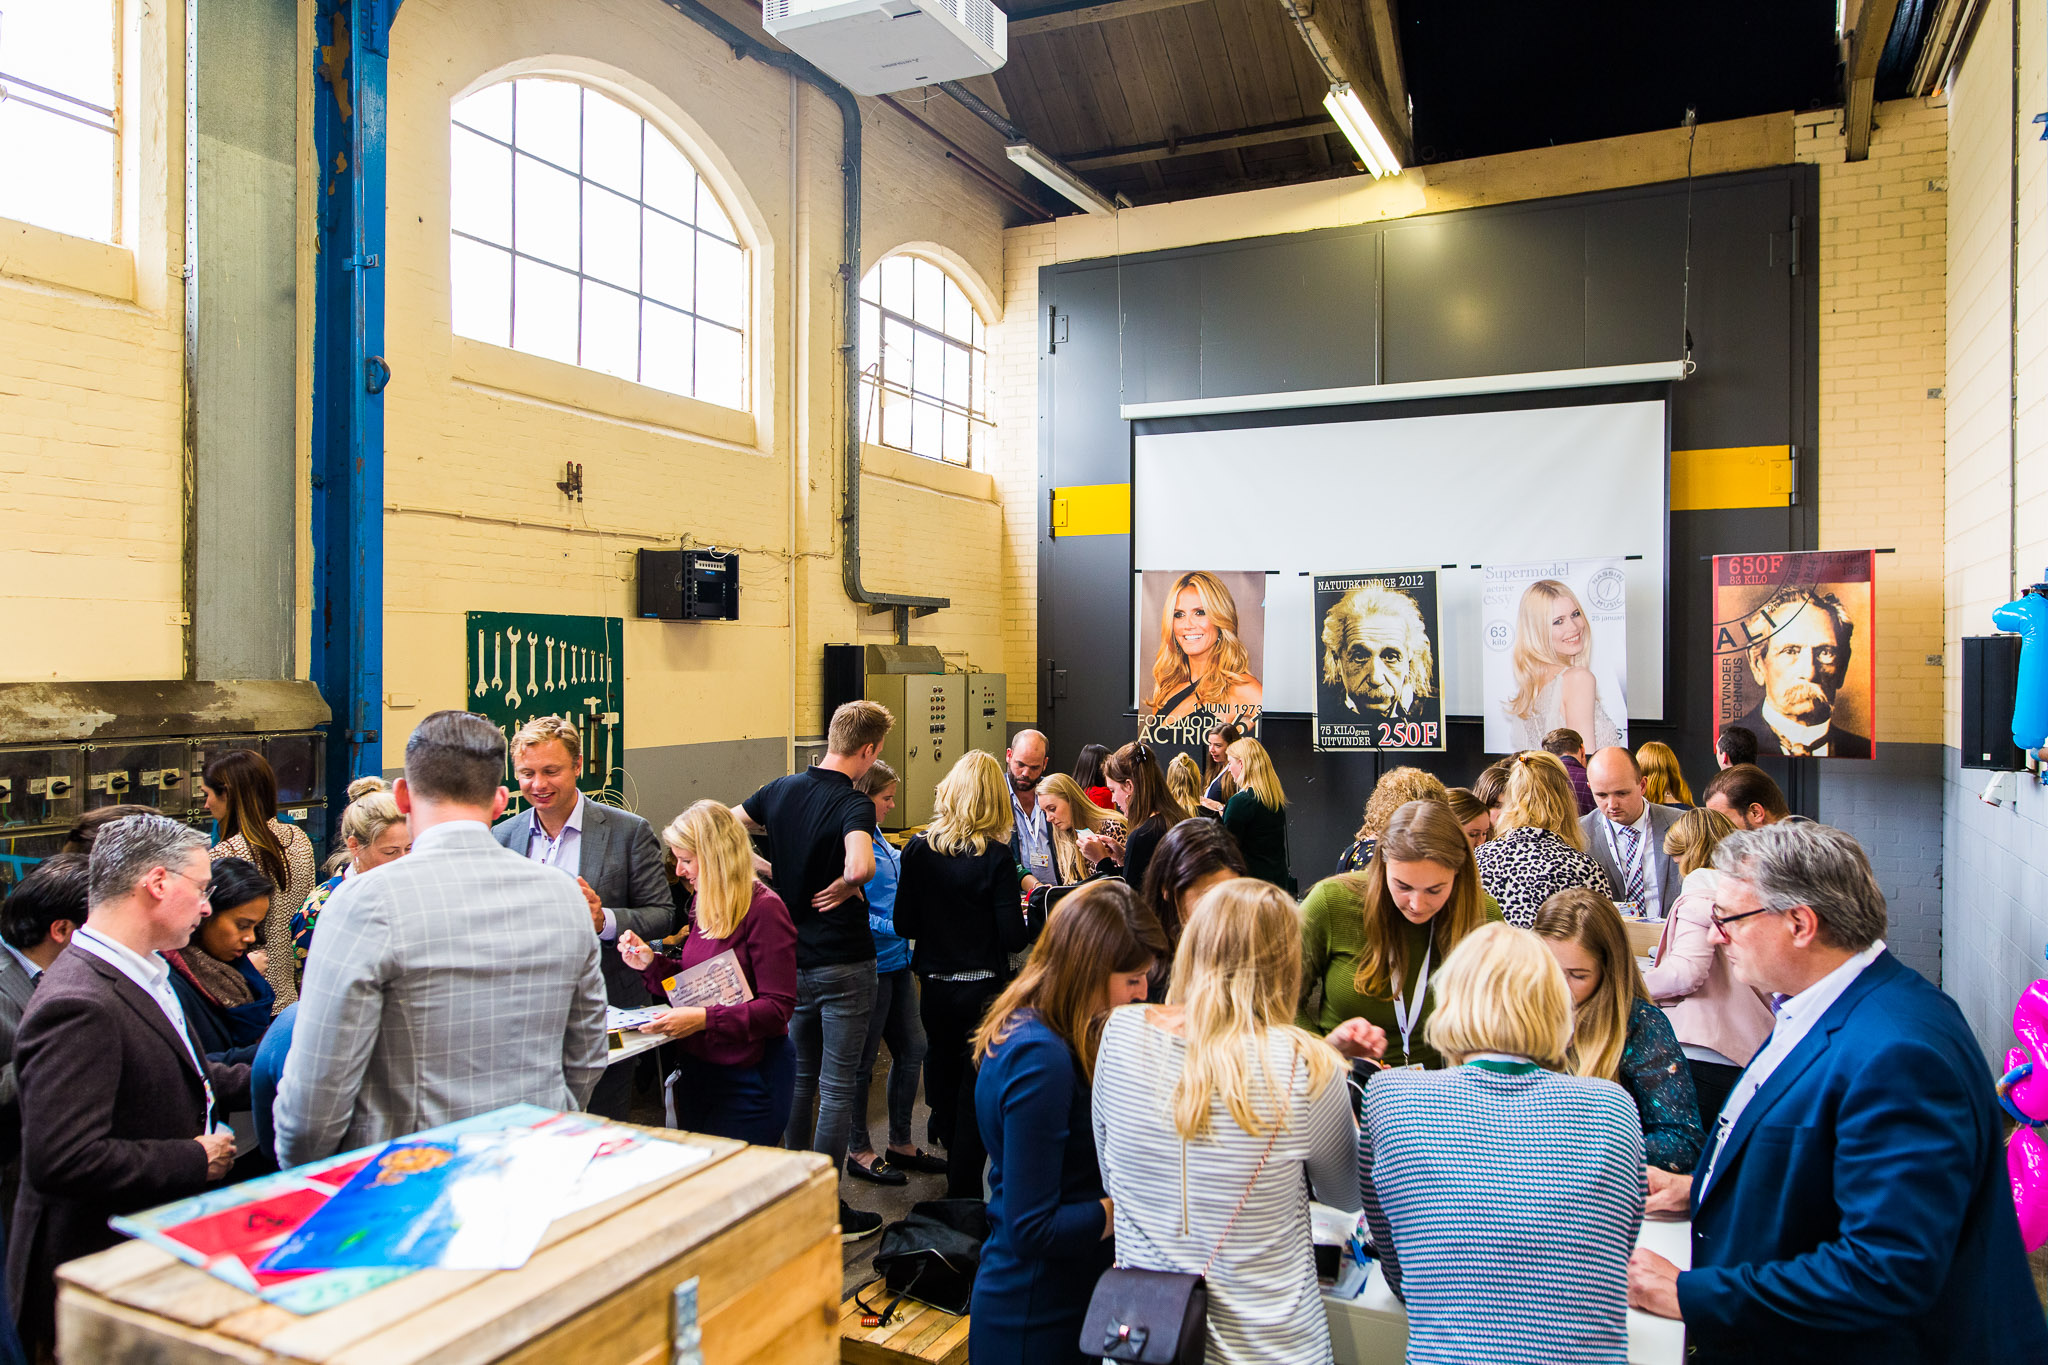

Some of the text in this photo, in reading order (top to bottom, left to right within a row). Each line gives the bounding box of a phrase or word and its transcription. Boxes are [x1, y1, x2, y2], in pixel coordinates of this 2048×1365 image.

[1729, 555, 1783, 575] 650F
[1485, 563, 1569, 582] Supermodel
[1318, 575, 1424, 591] NATUURKUNDIGE 2012
[1730, 575, 1768, 584] 83 KILO
[1486, 584, 1515, 593] actrice
[1597, 598, 1622, 608] MUSIC
[1601, 615, 1624, 623] januari
[1490, 626, 1507, 638] 63
[1492, 638, 1507, 646] kilo
[1722, 658, 1732, 719] UITVINDER
[1193, 703, 1262, 714] 1 JUNI 1973
[1320, 725, 1370, 737] 75 KILOgram
[1378, 722, 1438, 747] 250F
[1321, 737, 1371, 746] UITVINDER
